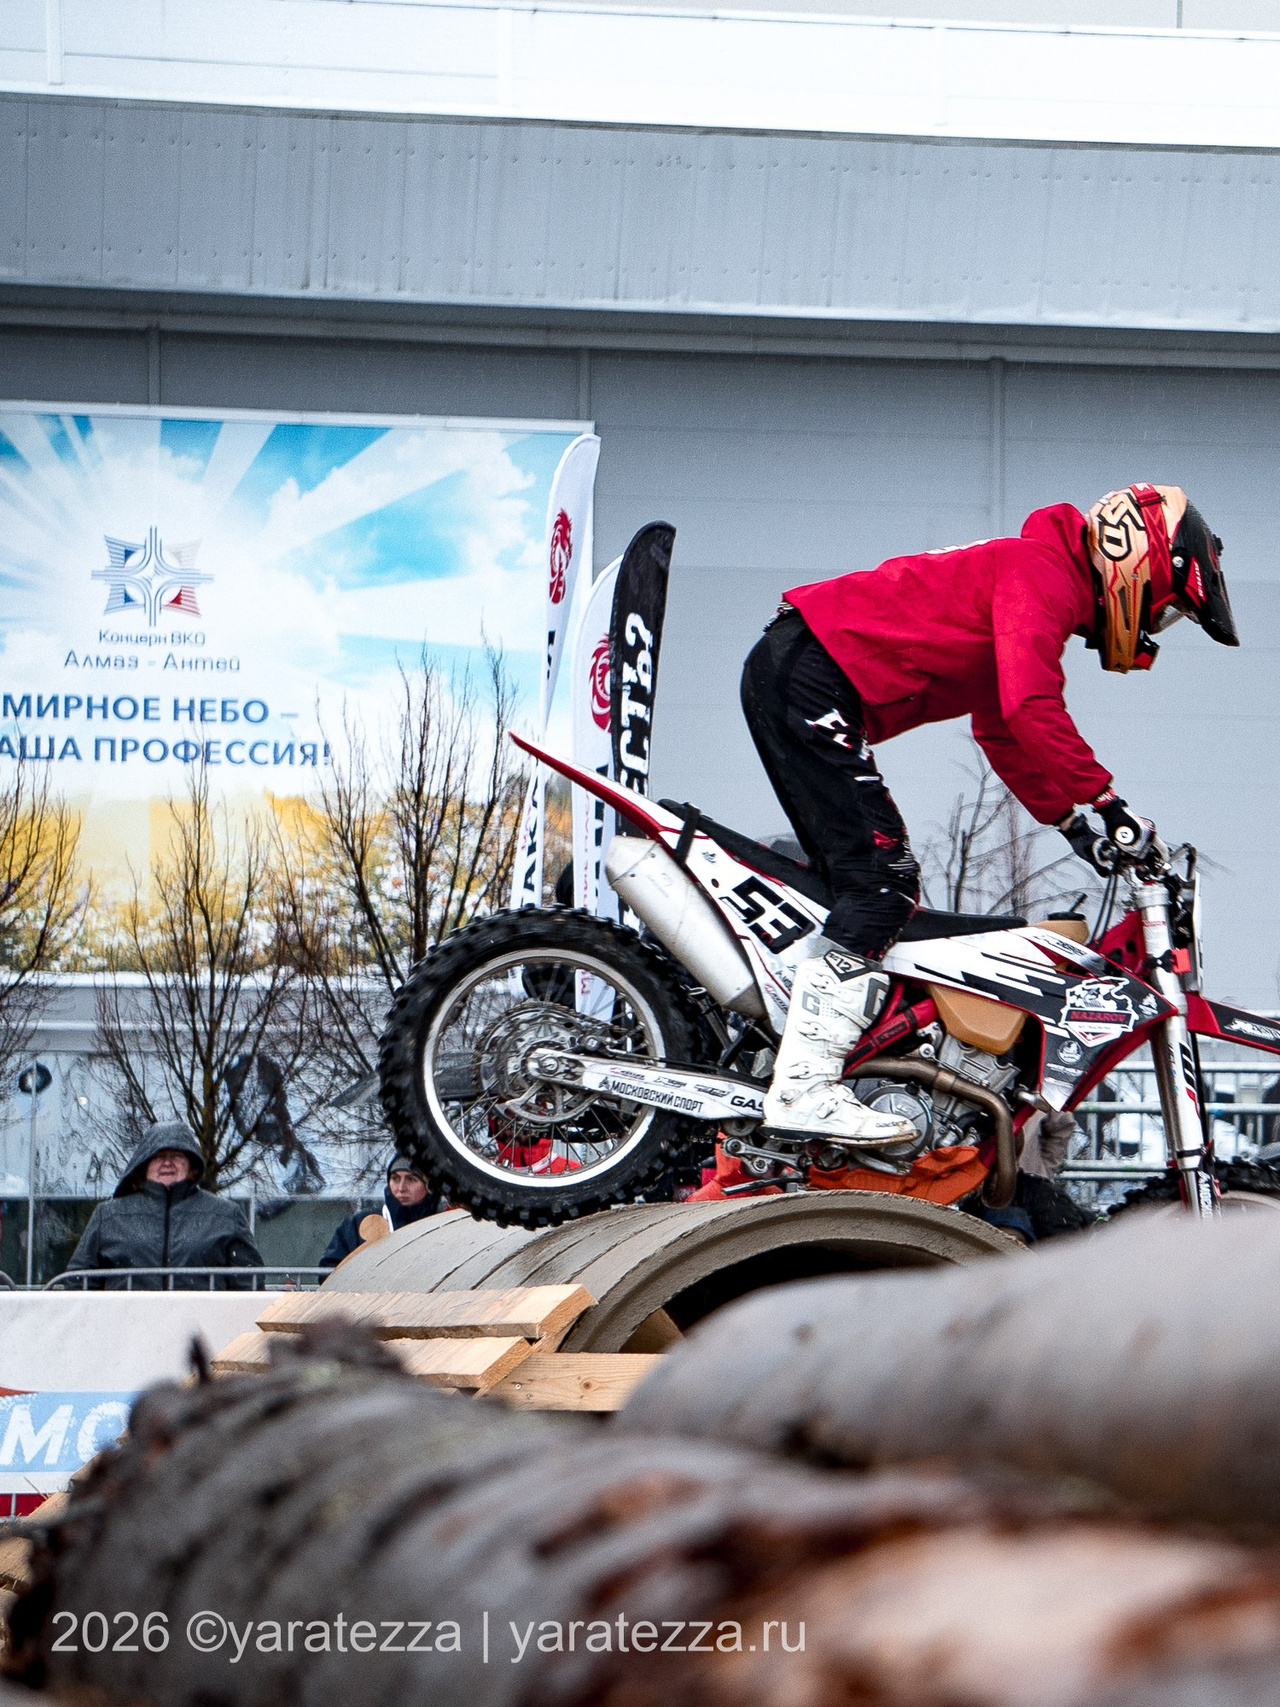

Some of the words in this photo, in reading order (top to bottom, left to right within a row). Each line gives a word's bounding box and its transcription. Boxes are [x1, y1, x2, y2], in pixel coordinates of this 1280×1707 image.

[99, 629, 167, 647] Концерн
[171, 631, 206, 646] ВКО
[64, 650, 139, 670] Алмаз
[163, 652, 241, 673] Антей
[2, 692, 161, 722] МИРНОЕ
[173, 696, 270, 724] НЕБО
[94, 735, 331, 768] ПРОФЕССИЯ!
[718, 875, 816, 955] 53
[610, 1079, 675, 1106] МОСКОВСКИЙ
[674, 1095, 704, 1114] СПОРТ
